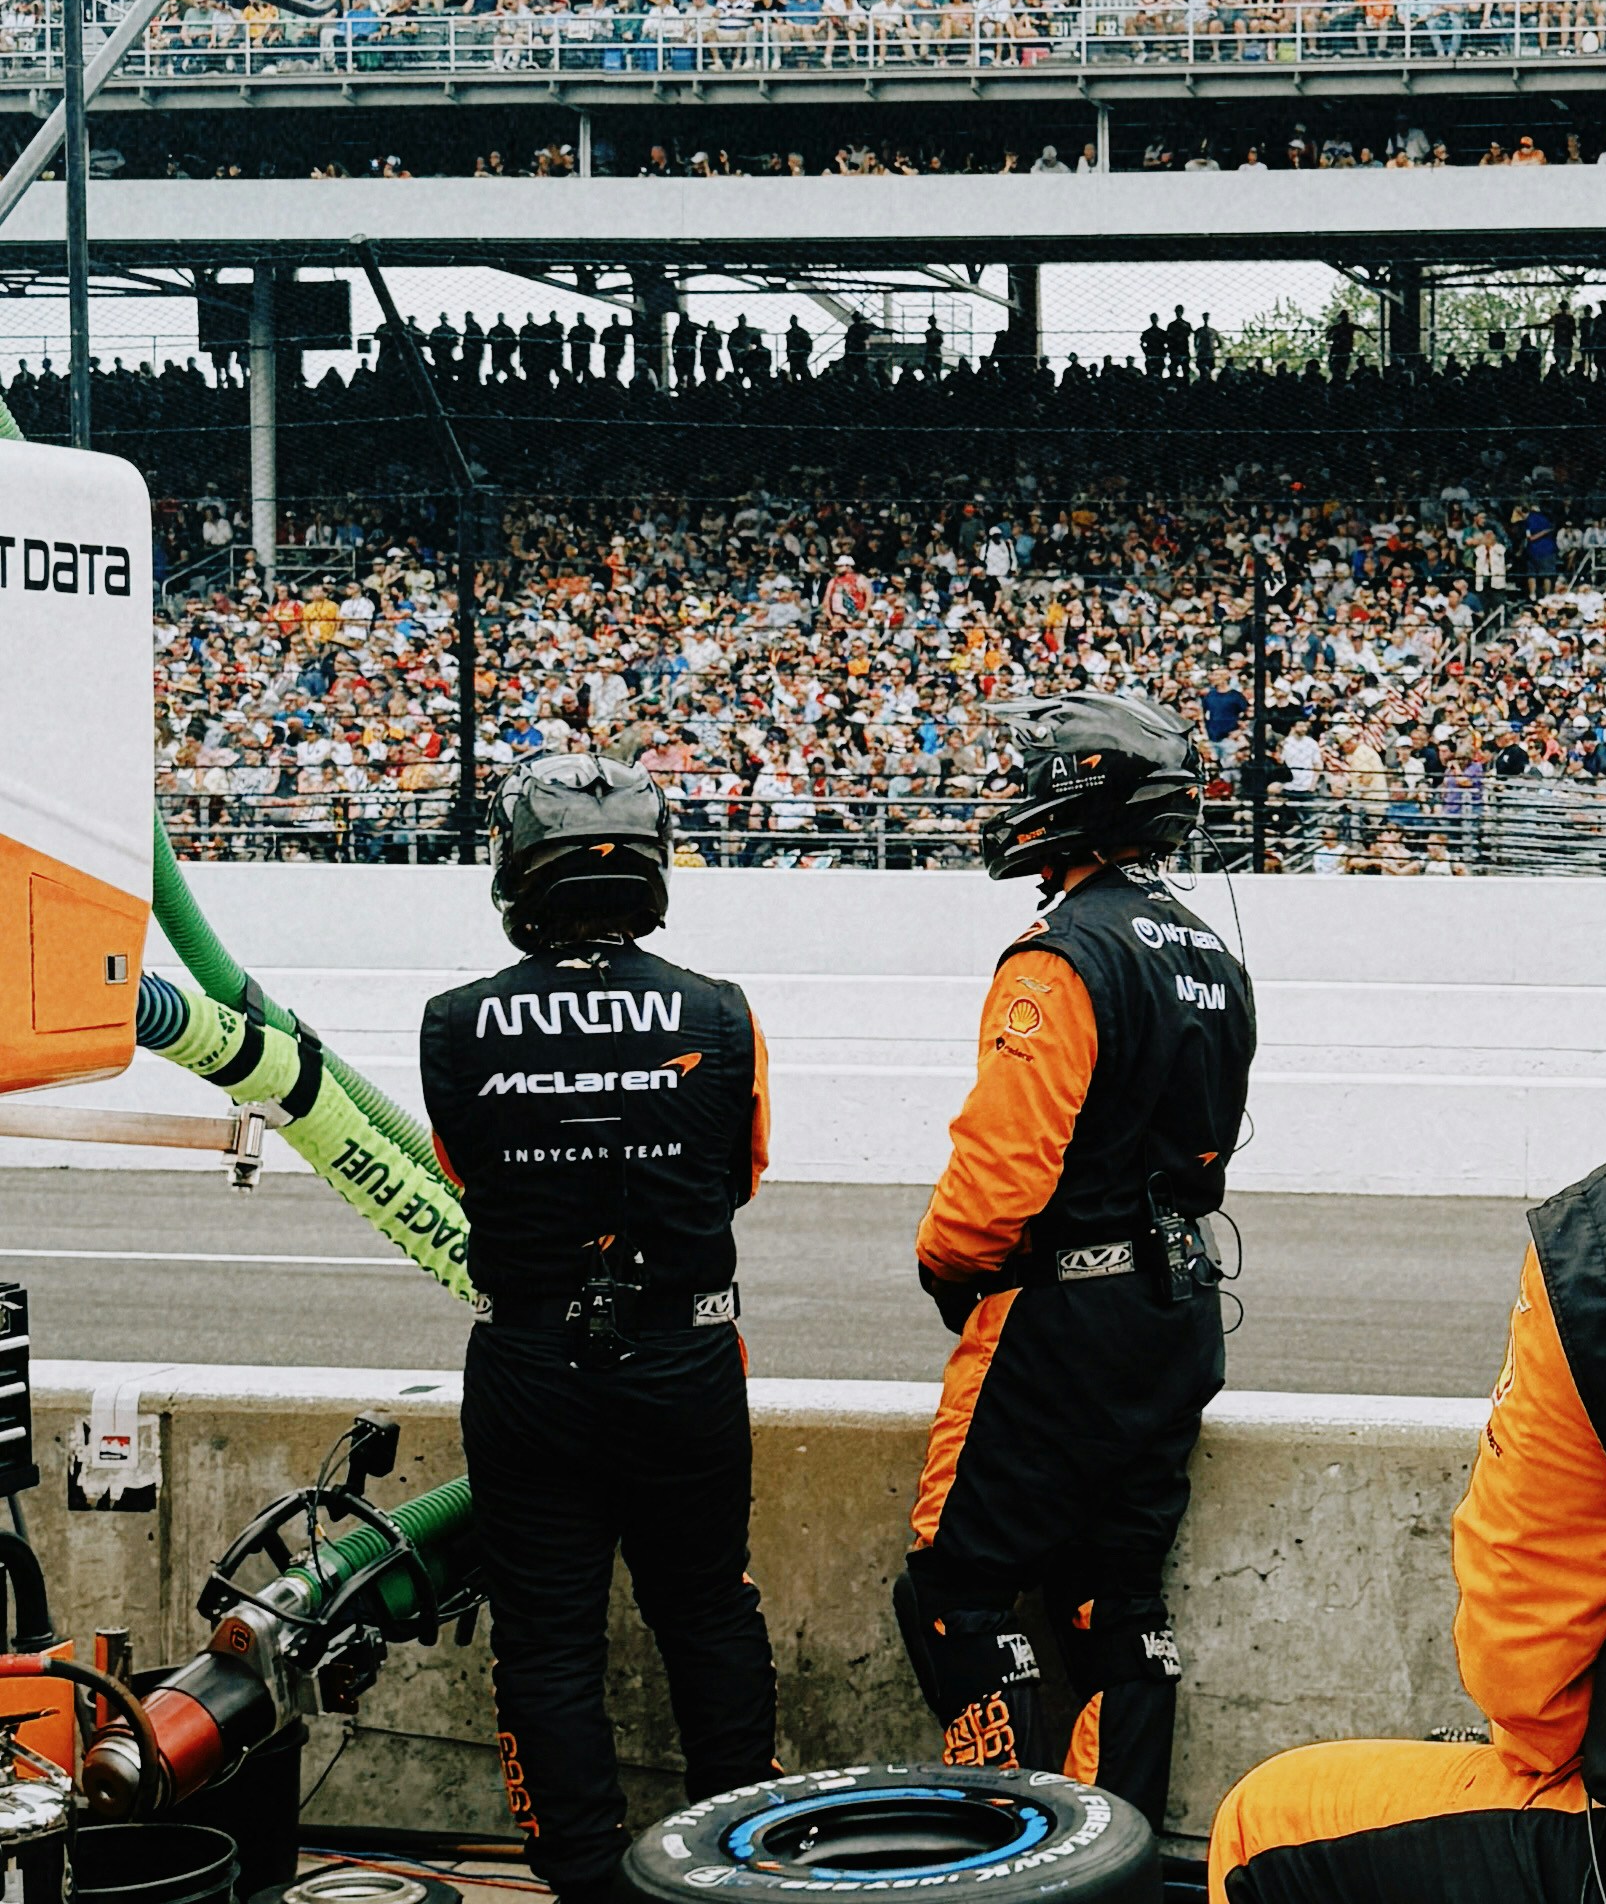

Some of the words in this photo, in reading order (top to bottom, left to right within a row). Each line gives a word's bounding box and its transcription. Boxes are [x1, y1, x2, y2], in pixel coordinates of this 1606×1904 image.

[475, 990, 682, 1039] ARROW
[478, 1069, 678, 1096] McLaren
[503, 1146, 609, 1163] INDYCAR
[624, 1143, 682, 1160] TEAM
[331, 1137, 405, 1208] FUEL
